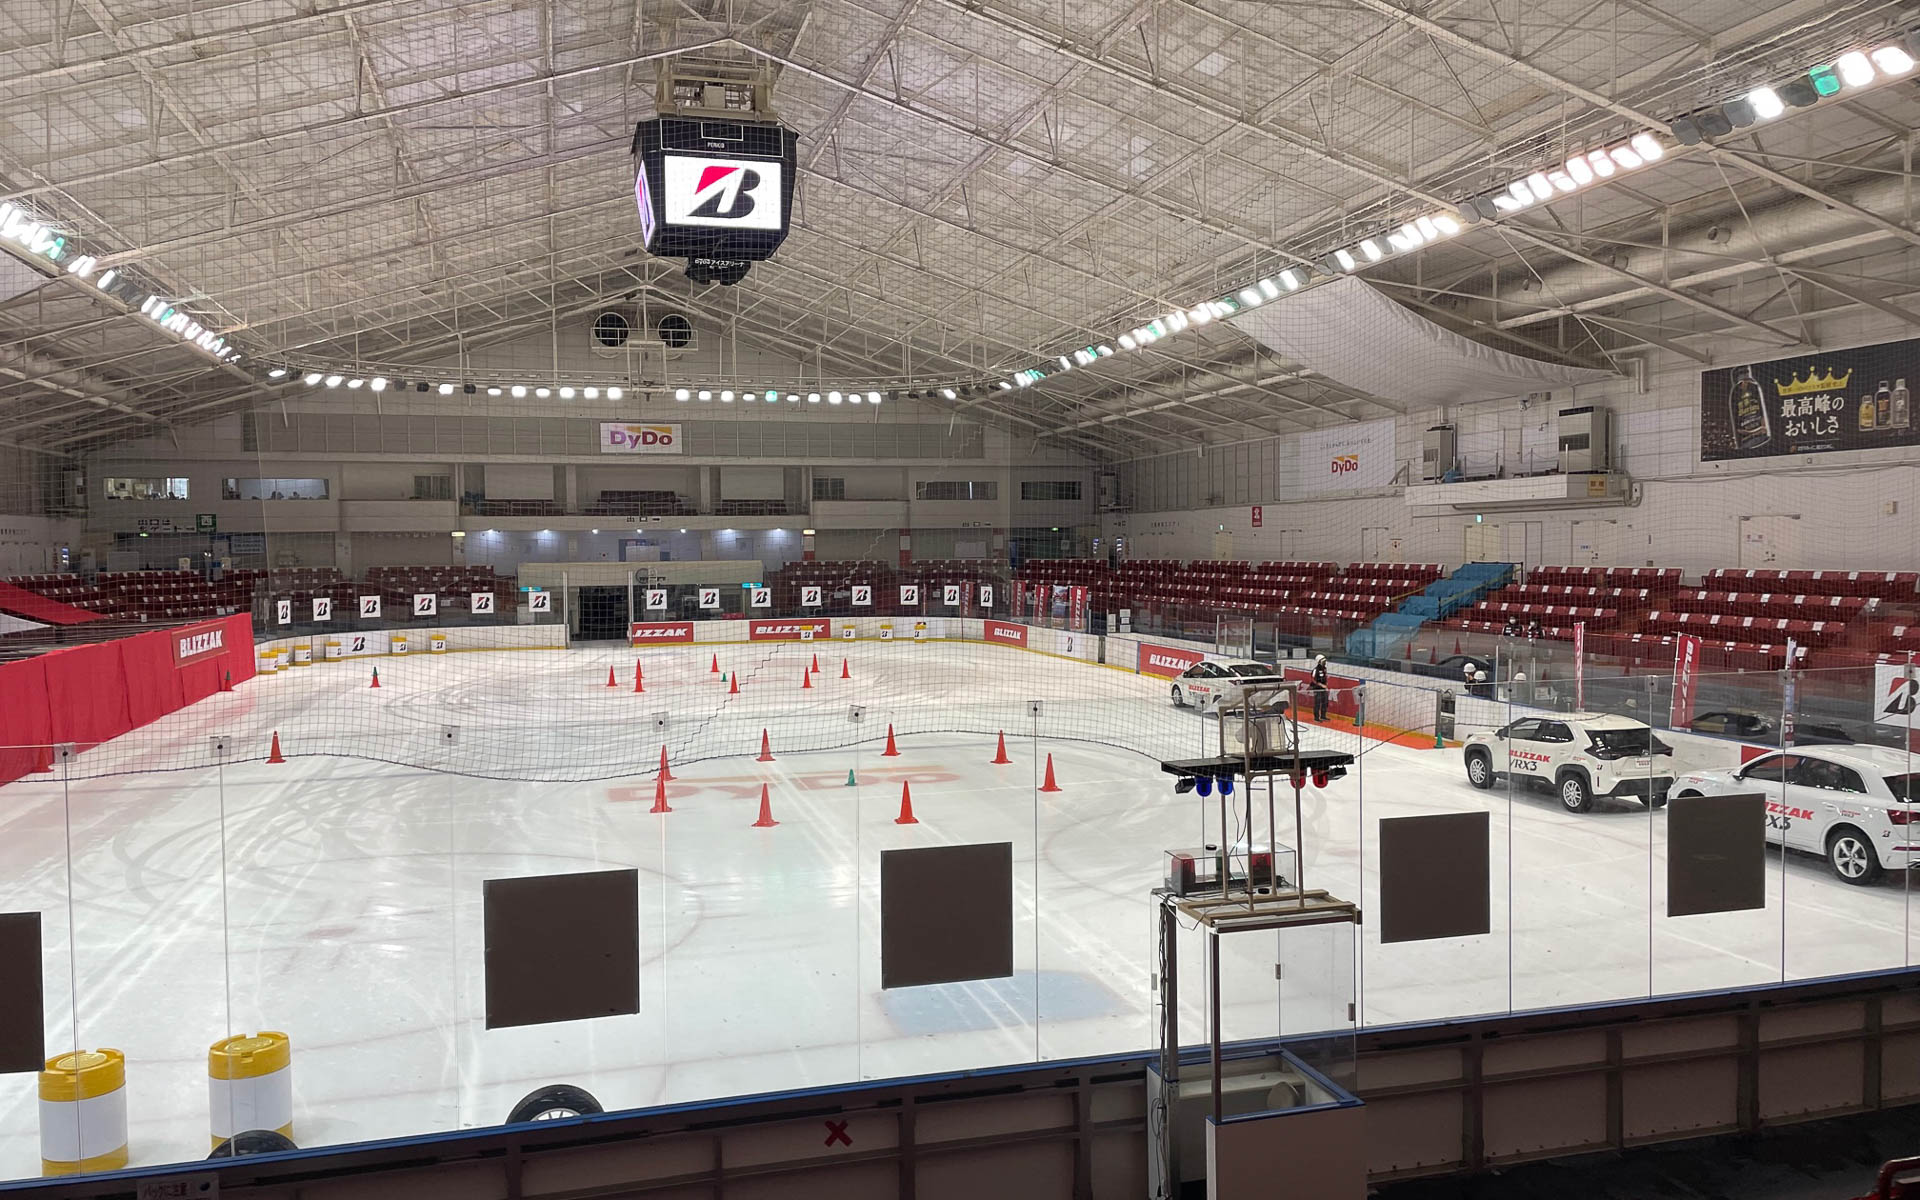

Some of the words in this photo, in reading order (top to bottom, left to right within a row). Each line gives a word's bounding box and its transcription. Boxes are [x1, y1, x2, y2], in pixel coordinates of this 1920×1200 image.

[1780, 394, 1845, 418] 最高峰の
[1785, 415, 1839, 437] おいしさ
[610, 431, 673, 449] DyDo
[1331, 459, 1359, 476] DyDo
[755, 624, 825, 634] BLIZZK
[993, 627, 1021, 640] BLIZZAK
[180, 630, 223, 658] BLIZZAK
[1149, 653, 1192, 670] BLIZZAK
